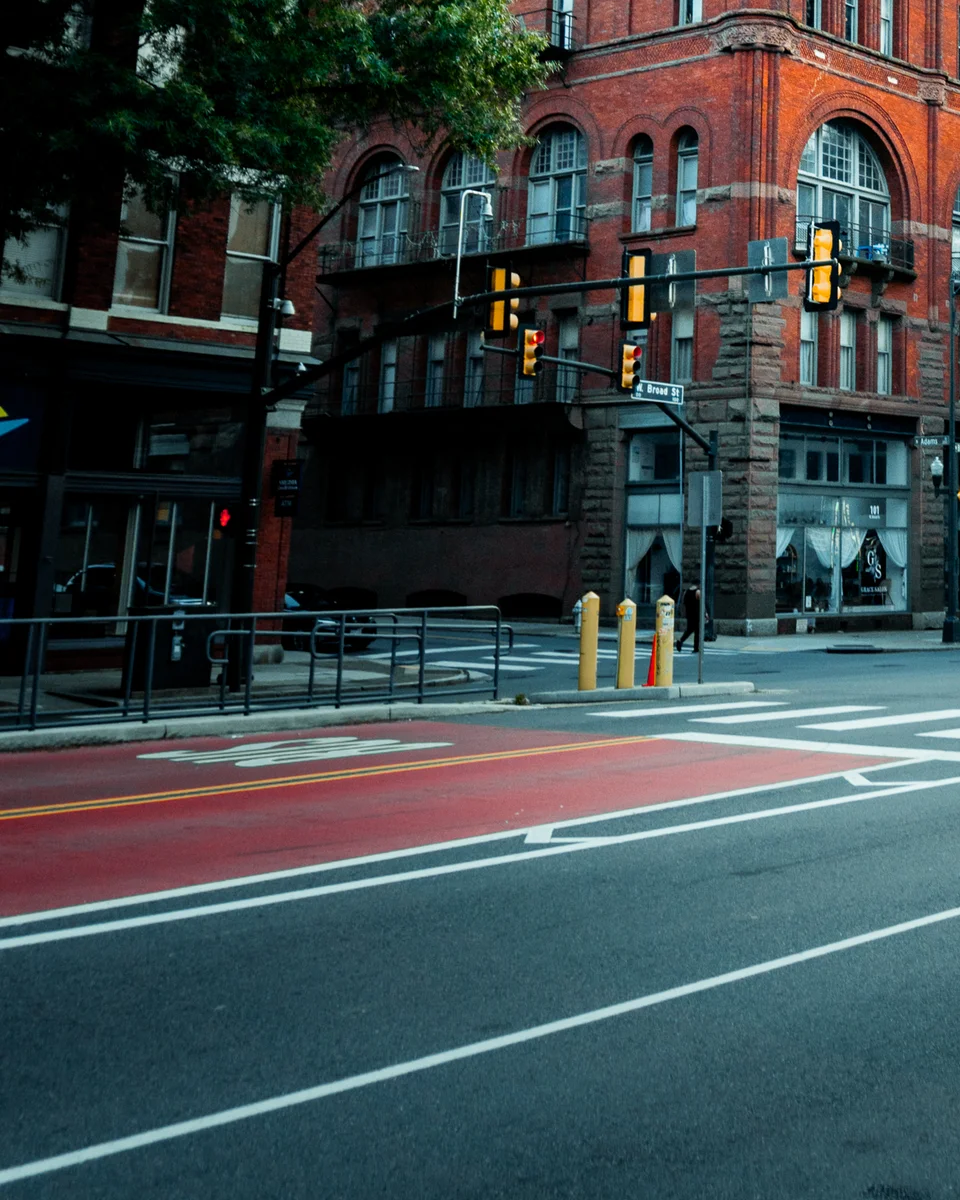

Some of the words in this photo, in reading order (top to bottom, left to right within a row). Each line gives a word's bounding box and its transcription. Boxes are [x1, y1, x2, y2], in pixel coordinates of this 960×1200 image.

[647, 384, 668, 396] Broad
[671, 387, 680, 396] St
[920, 437, 938, 445] Adams
[870, 505, 880, 514] 101
[868, 551, 875, 566] G
[874, 564, 882, 579] S
